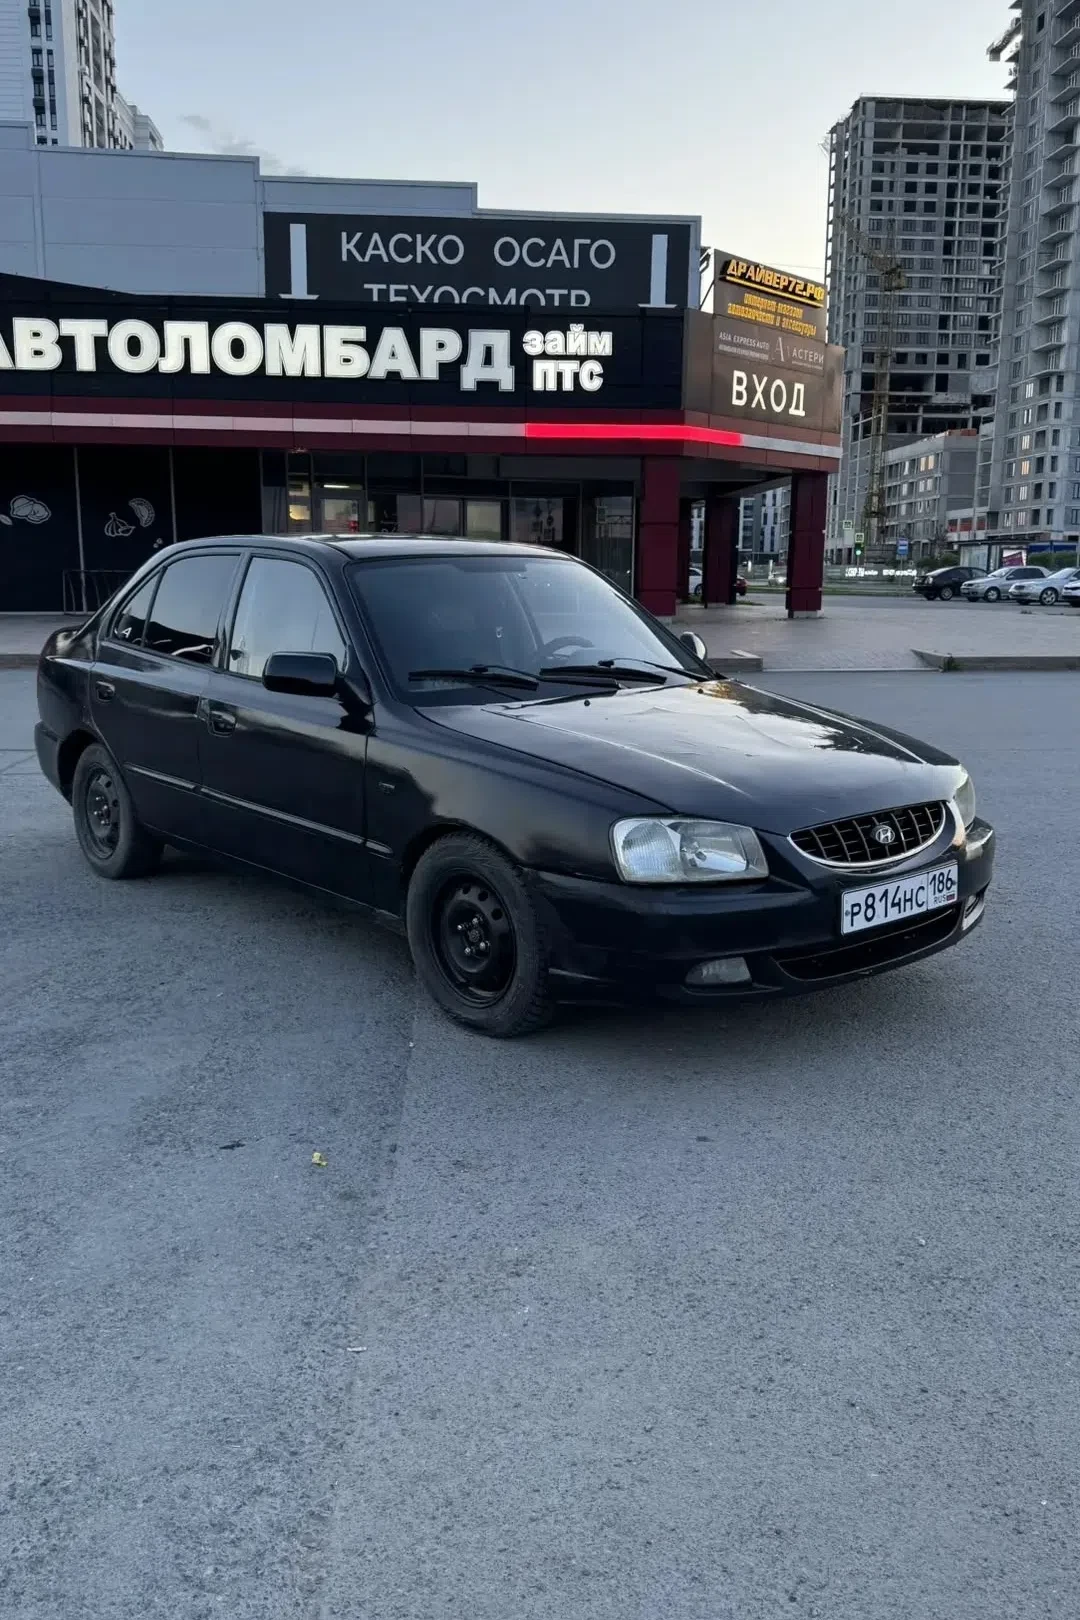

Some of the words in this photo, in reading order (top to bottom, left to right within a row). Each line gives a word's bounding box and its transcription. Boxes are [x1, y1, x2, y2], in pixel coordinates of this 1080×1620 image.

[341, 231, 464, 265] КАСКО
[493, 236, 616, 269] ОСАГО
[726, 259, 825, 301] ДРАЙВЕР72.РФ
[522, 323, 613, 356] займ
[719, 331, 732, 341] ASIA
[733, 335, 757, 348] EXPRESS
[731, 369, 806, 417] ВХОД
[930, 869, 954, 896] 186
[933, 894, 947, 905] RUS
